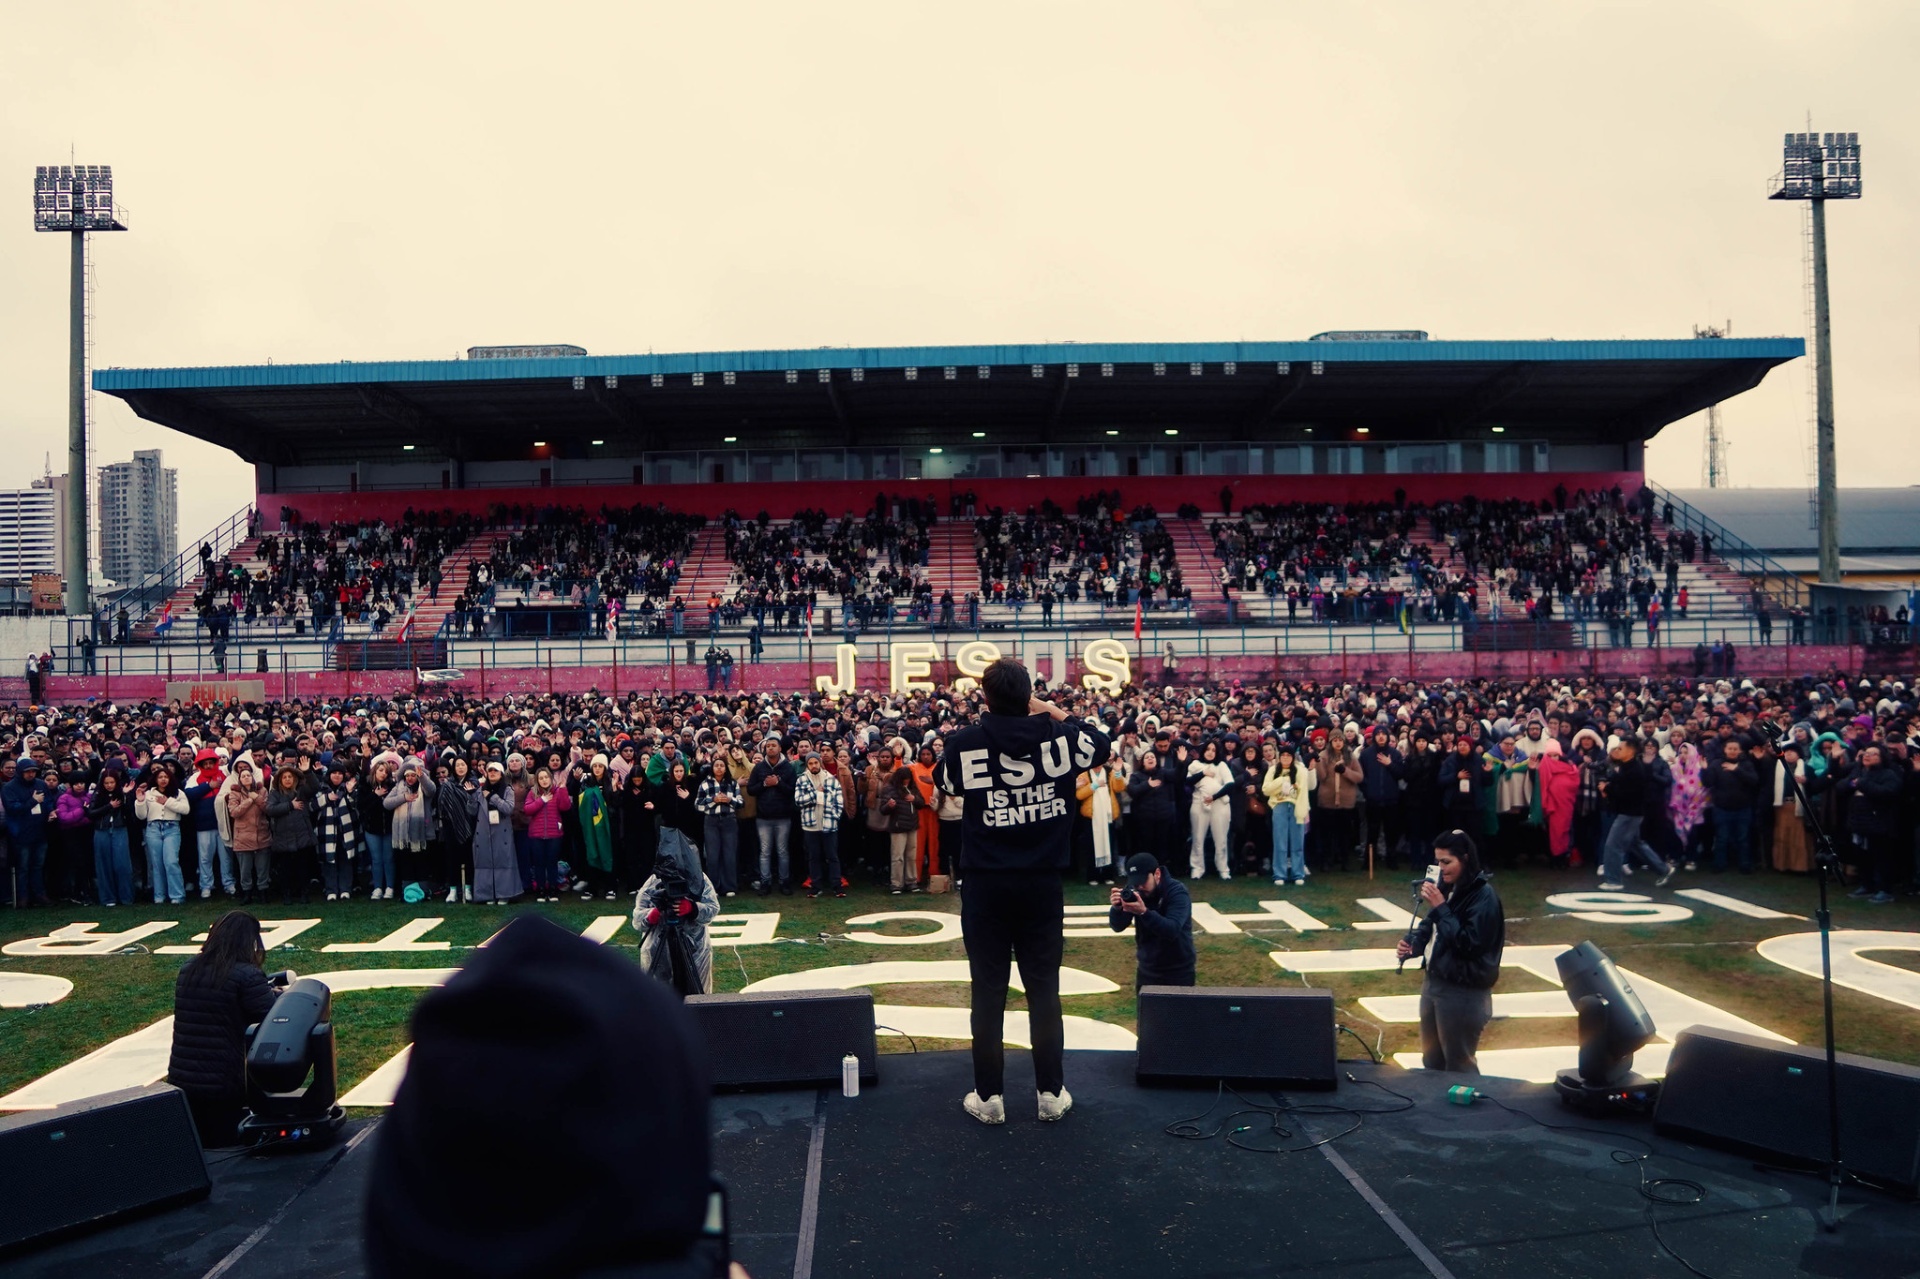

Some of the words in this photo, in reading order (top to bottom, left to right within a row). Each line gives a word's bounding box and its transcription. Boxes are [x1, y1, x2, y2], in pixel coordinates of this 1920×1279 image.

[815, 639, 1131, 700] JESUS
[986, 790, 1010, 809] IS
[1011, 782, 1056, 806] THE
[983, 798, 1067, 827] CENTER
